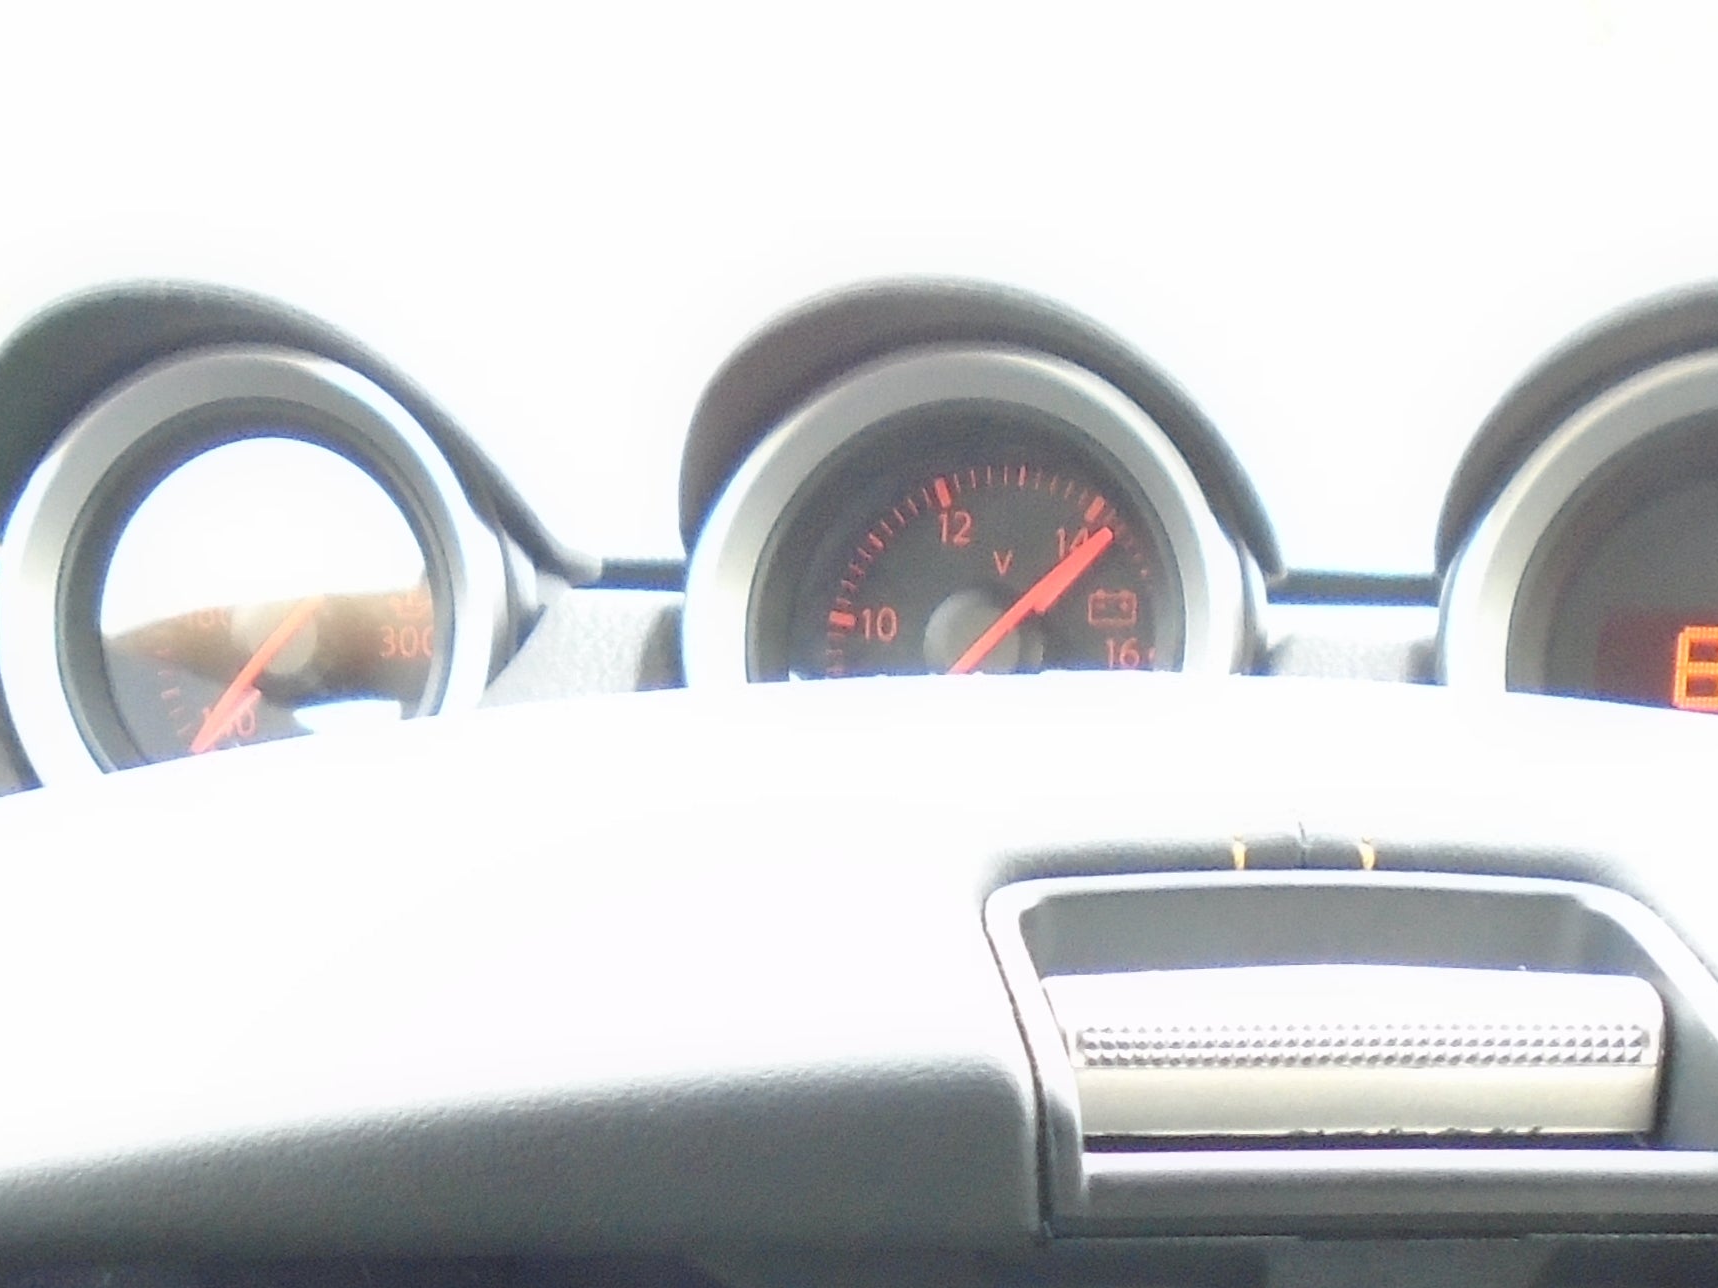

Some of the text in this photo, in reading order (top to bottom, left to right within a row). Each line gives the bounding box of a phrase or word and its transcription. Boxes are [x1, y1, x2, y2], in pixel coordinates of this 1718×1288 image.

[940, 512, 972, 545] 12
[994, 550, 1014, 577] V
[862, 607, 899, 643] 10
[1105, 637, 1141, 669] 16
